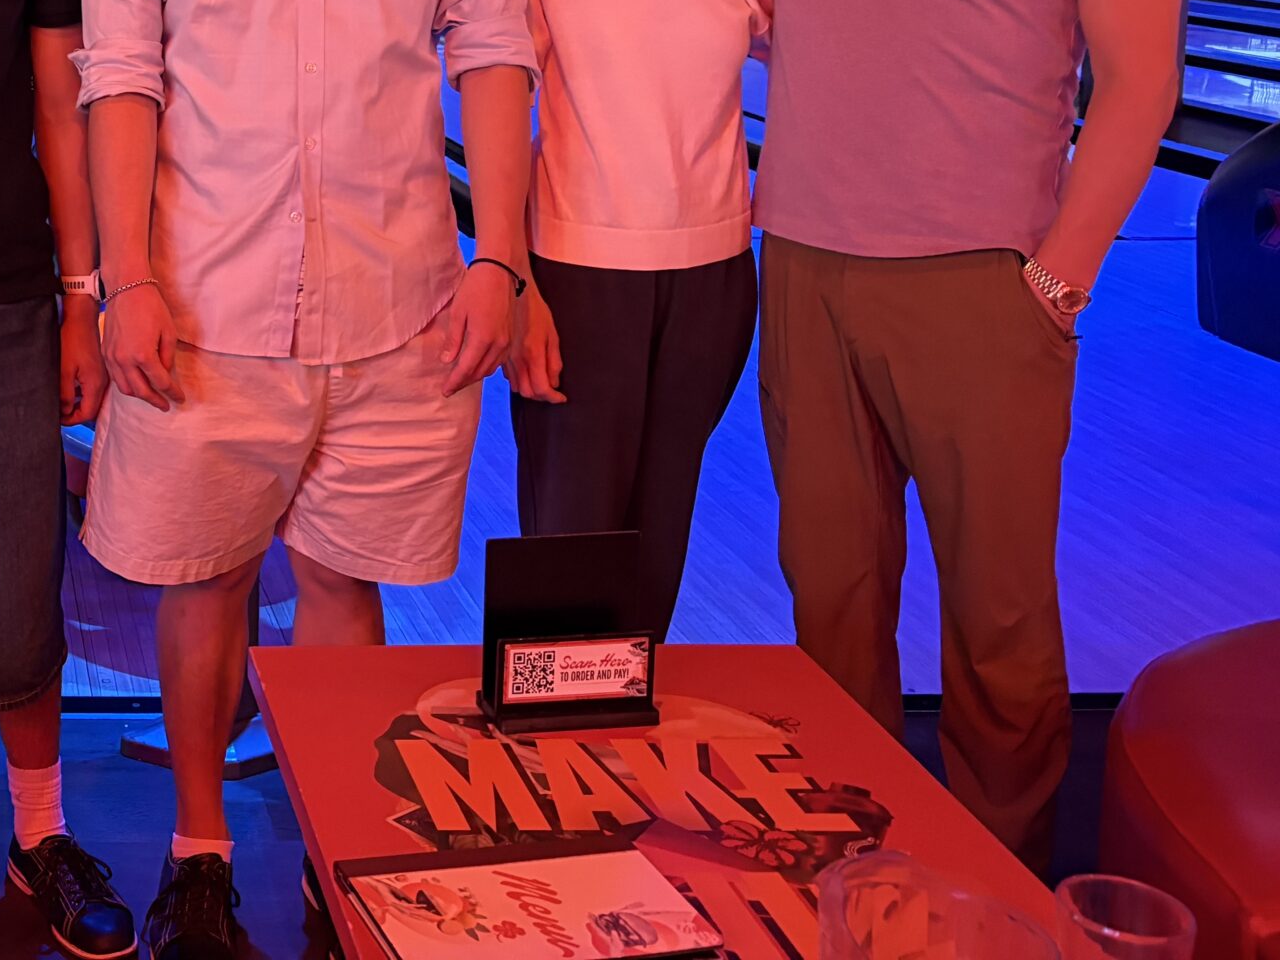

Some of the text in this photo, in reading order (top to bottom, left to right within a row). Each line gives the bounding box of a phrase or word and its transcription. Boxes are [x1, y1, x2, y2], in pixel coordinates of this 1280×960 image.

[559, 653, 632, 669] Scan Here
[560, 668, 629, 682] TO ORDER AND PAY!
[396, 739, 862, 833] MAKE
[492, 870, 580, 959] Menu
